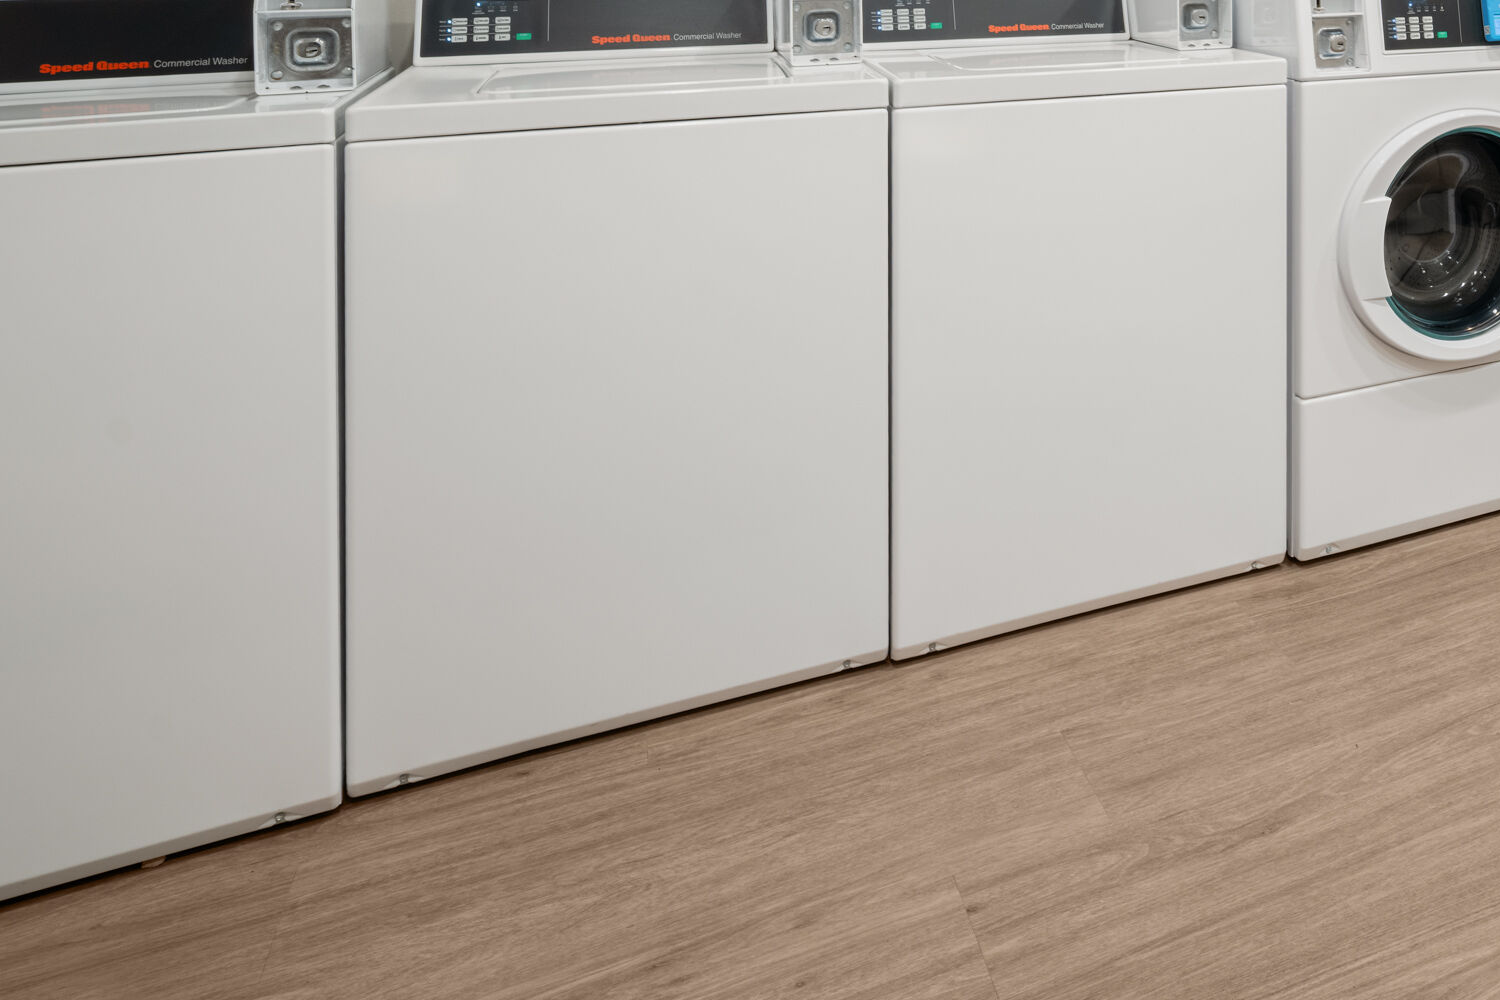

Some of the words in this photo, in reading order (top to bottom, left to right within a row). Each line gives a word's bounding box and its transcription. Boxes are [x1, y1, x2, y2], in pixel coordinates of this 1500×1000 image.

[988, 24, 1019, 34] Speed
[1019, 23, 1050, 32] Queen
[1051, 23, 1084, 31] Commercial
[591, 34, 631, 45] Speed
[632, 33, 671, 42] Queen
[673, 32, 715, 41] Commercial
[716, 31, 742, 39] Washer
[39, 61, 94, 75] Speed
[96, 60, 150, 71] Queen
[153, 58, 211, 69] Commercial
[212, 56, 249, 66] Washer
